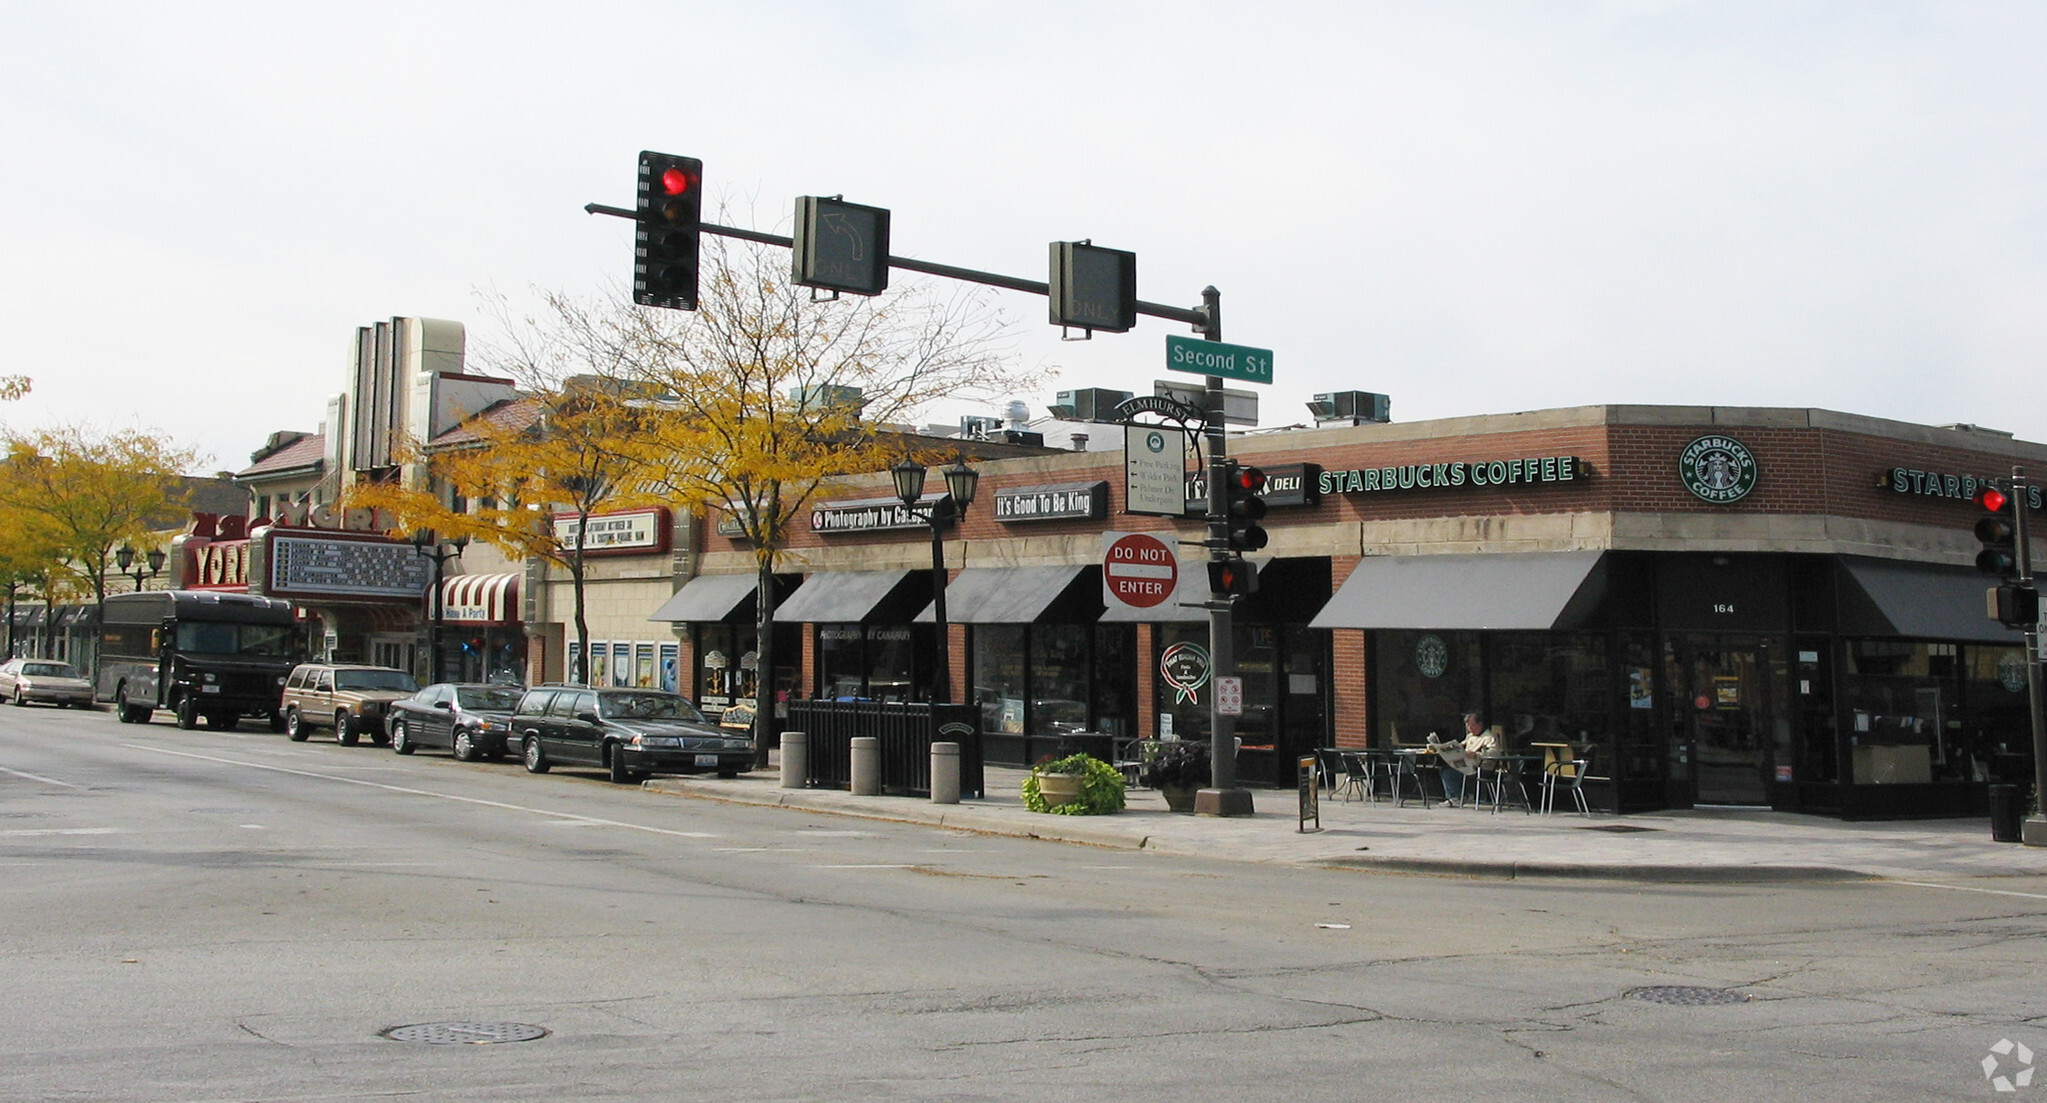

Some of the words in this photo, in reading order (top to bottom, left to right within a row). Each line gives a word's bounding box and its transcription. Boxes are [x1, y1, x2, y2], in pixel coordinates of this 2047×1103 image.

[1174, 345, 1235, 370] Second
[1246, 356, 1266, 375] St
[1122, 399, 1189, 422] ELMHURST
[1683, 438, 1752, 467] STARBUCKS
[1274, 476, 1300, 491] DELI
[1318, 461, 1466, 495] STARBUCKS
[1470, 456, 1574, 486] COFFEE
[1692, 482, 1745, 500] COFFEE
[1893, 467, 2042, 509] STARBS
[997, 497, 1011, 516] It's
[1014, 495, 1037, 515] Good
[1039, 494, 1050, 513] To
[1053, 493, 1065, 512] Be
[1068, 492, 1090, 513] King
[824, 509, 879, 529] Photography
[880, 507, 892, 527] by
[894, 505, 934, 526] Caapar
[1114, 546, 1133, 559] DO
[1140, 548, 1167, 561] NOT
[1120, 581, 1162, 594] ENTER
[1713, 604, 1734, 613] 164
